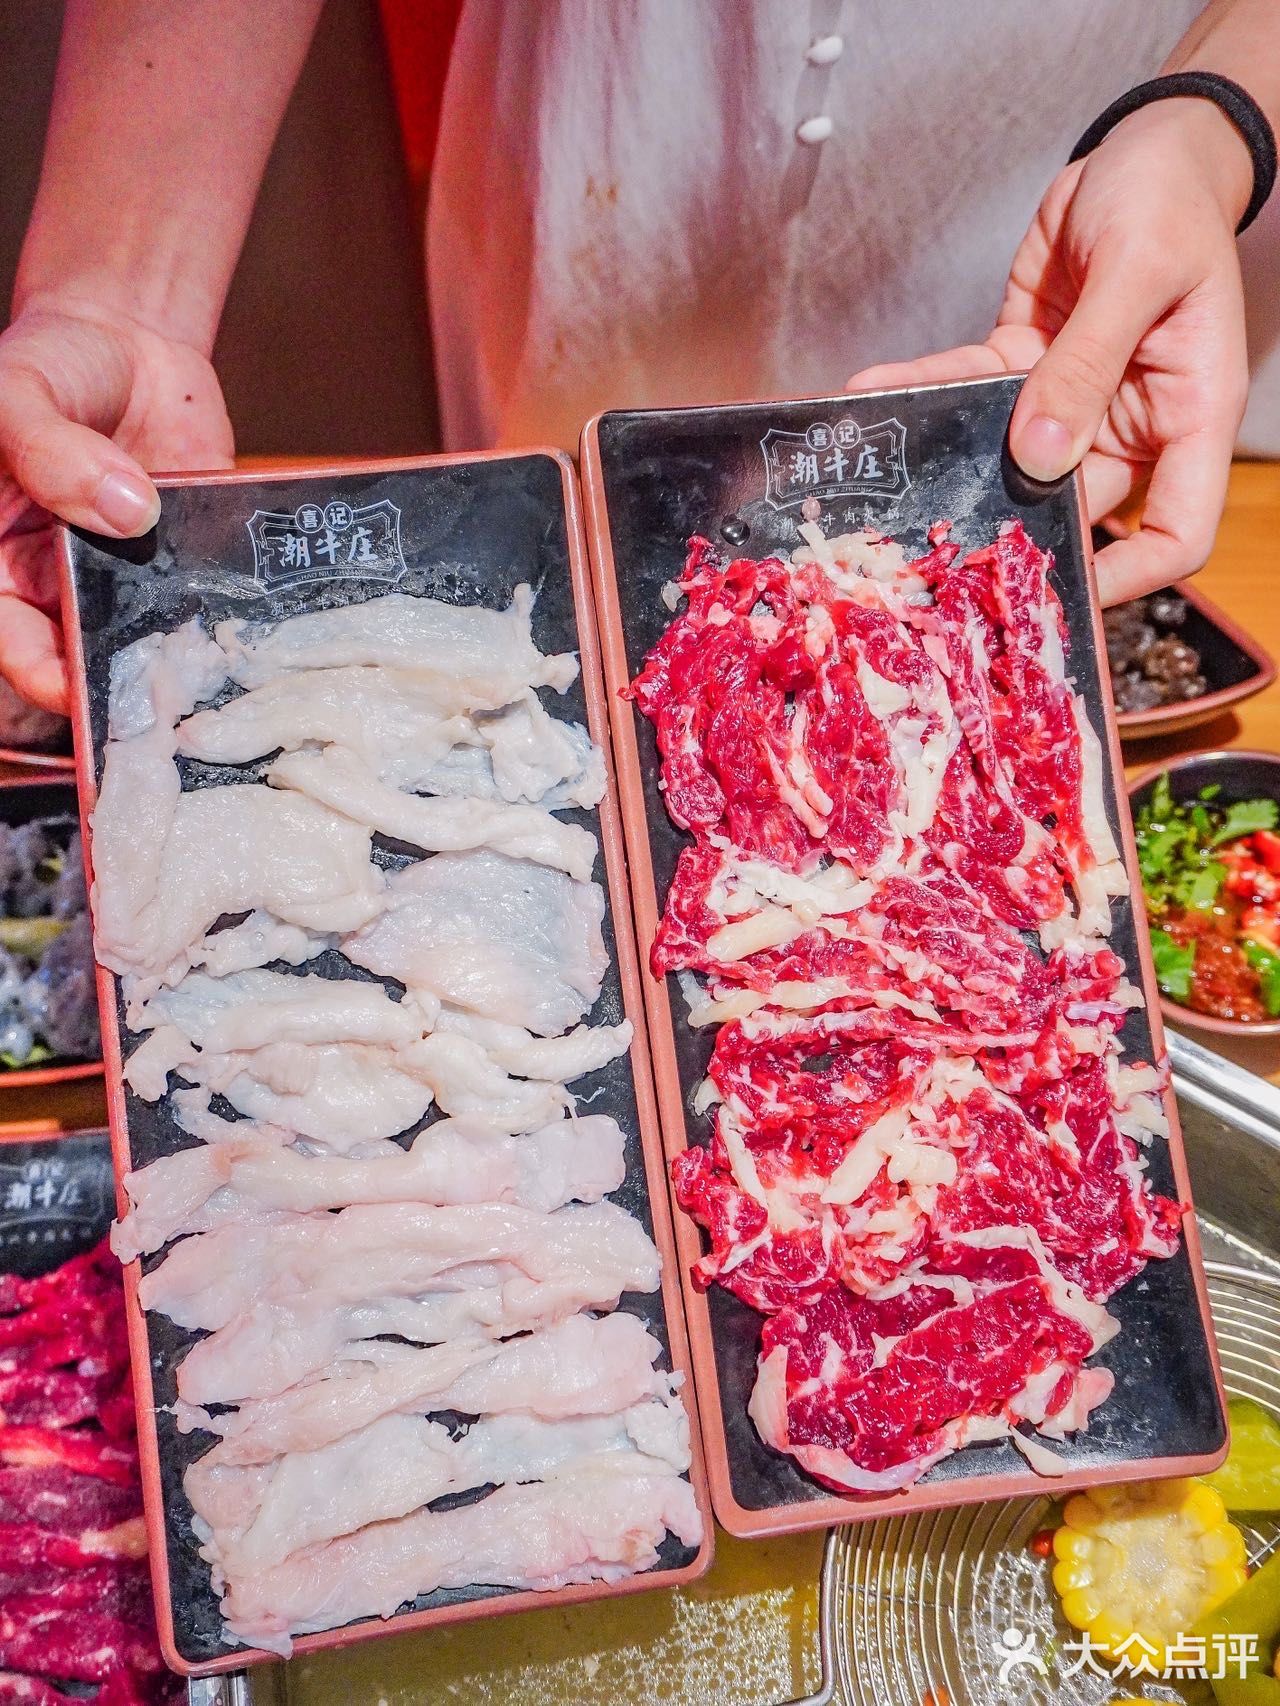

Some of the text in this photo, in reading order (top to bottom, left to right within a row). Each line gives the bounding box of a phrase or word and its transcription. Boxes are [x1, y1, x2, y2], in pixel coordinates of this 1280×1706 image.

[812, 425, 856, 447] 喜记
[789, 444, 884, 485] 潮牛庄
[302, 506, 348, 529] 喜记
[278, 526, 379, 568] 潮牛庄
